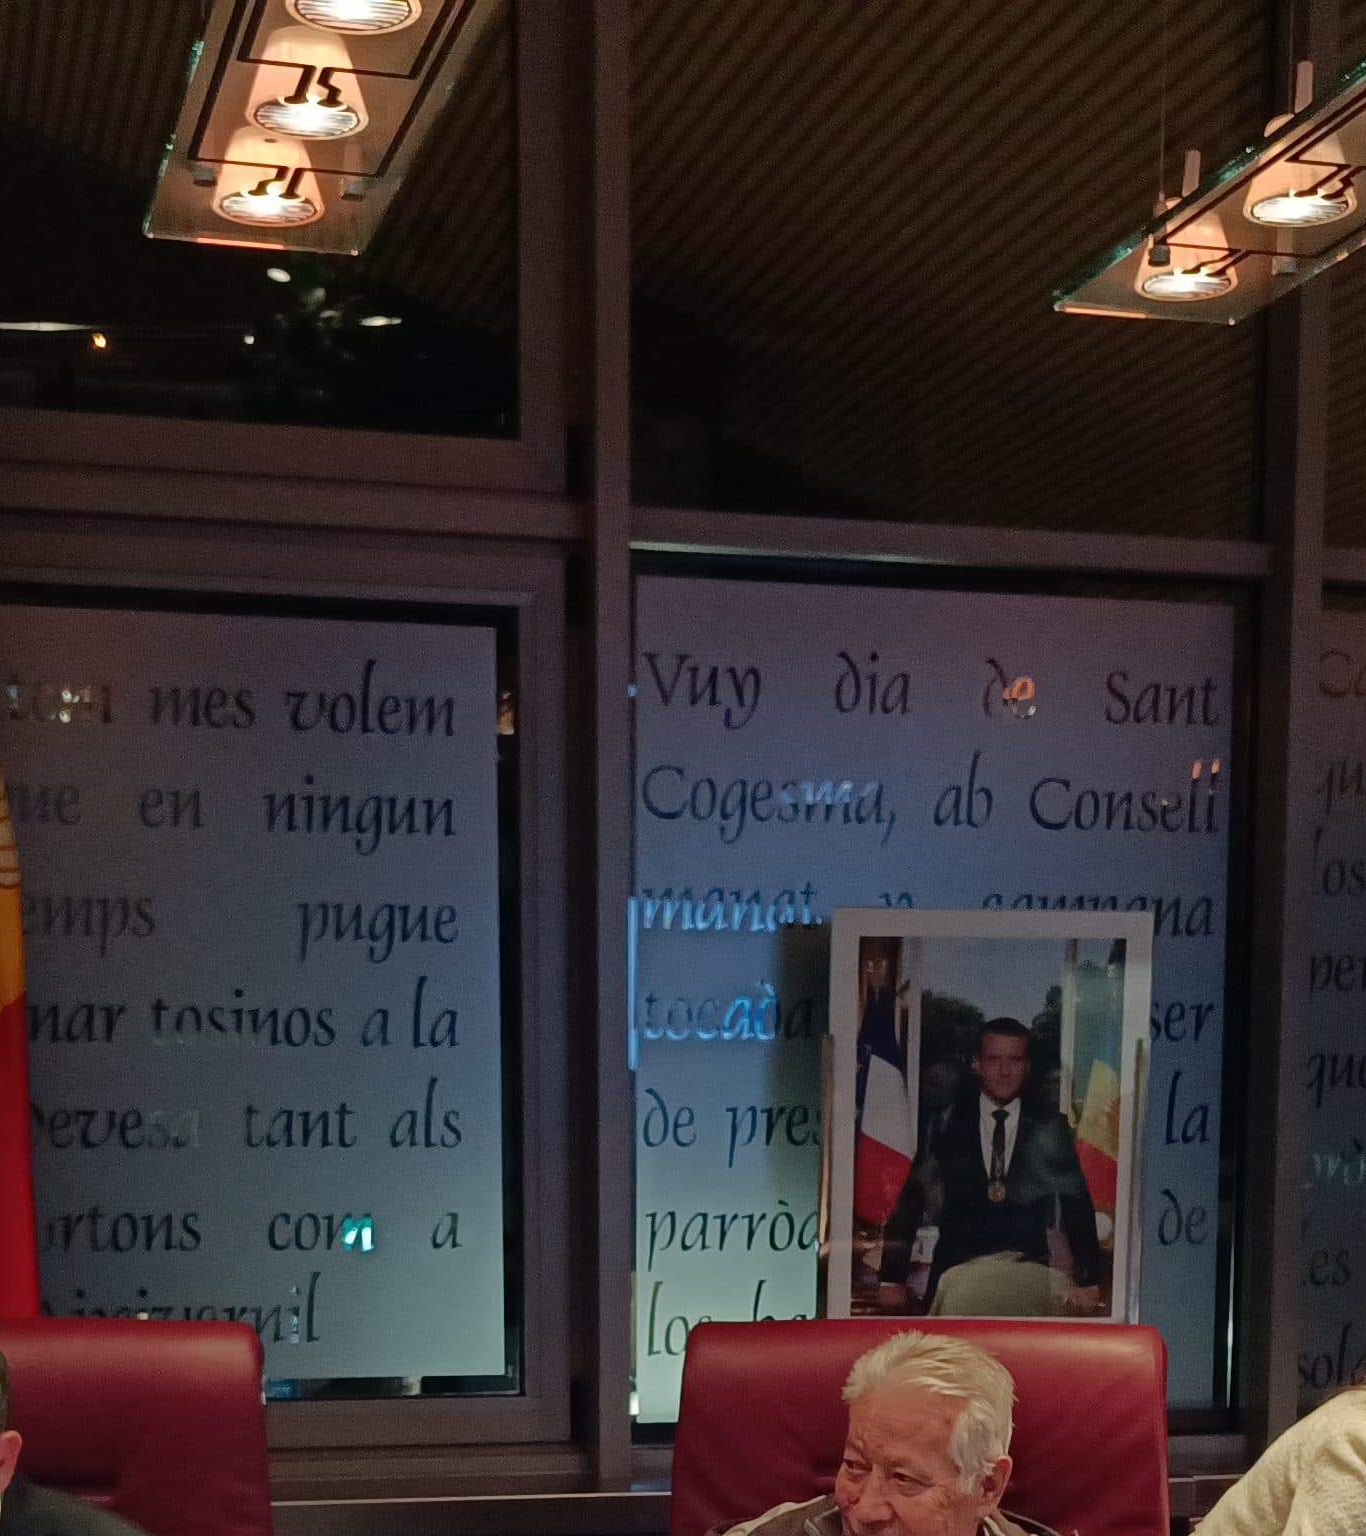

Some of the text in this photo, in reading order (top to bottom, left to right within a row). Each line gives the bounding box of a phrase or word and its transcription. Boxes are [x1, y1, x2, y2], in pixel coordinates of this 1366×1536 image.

[149, 684, 257, 731] mes
[285, 658, 455, 738] volem
[645, 651, 762, 730] Vuy
[835, 651, 912, 716] dia
[1104, 670, 1220, 727] Sant
[139, 784, 204, 830] en
[261, 773, 458, 857] ningun
[641, 748, 1223, 847] Cogesma, ab Consell
[298, 901, 460, 965] pugue
[27, 1001, 127, 1045] nar
[360, 1005, 391, 1048] a
[412, 975, 461, 1050] la
[244, 1099, 358, 1149] tant
[388, 1076, 464, 1149] als
[642, 1088, 697, 1148] de
[1164, 1069, 1211, 1147] la
[430, 1211, 463, 1251] a
[1157, 1188, 1209, 1247] de
